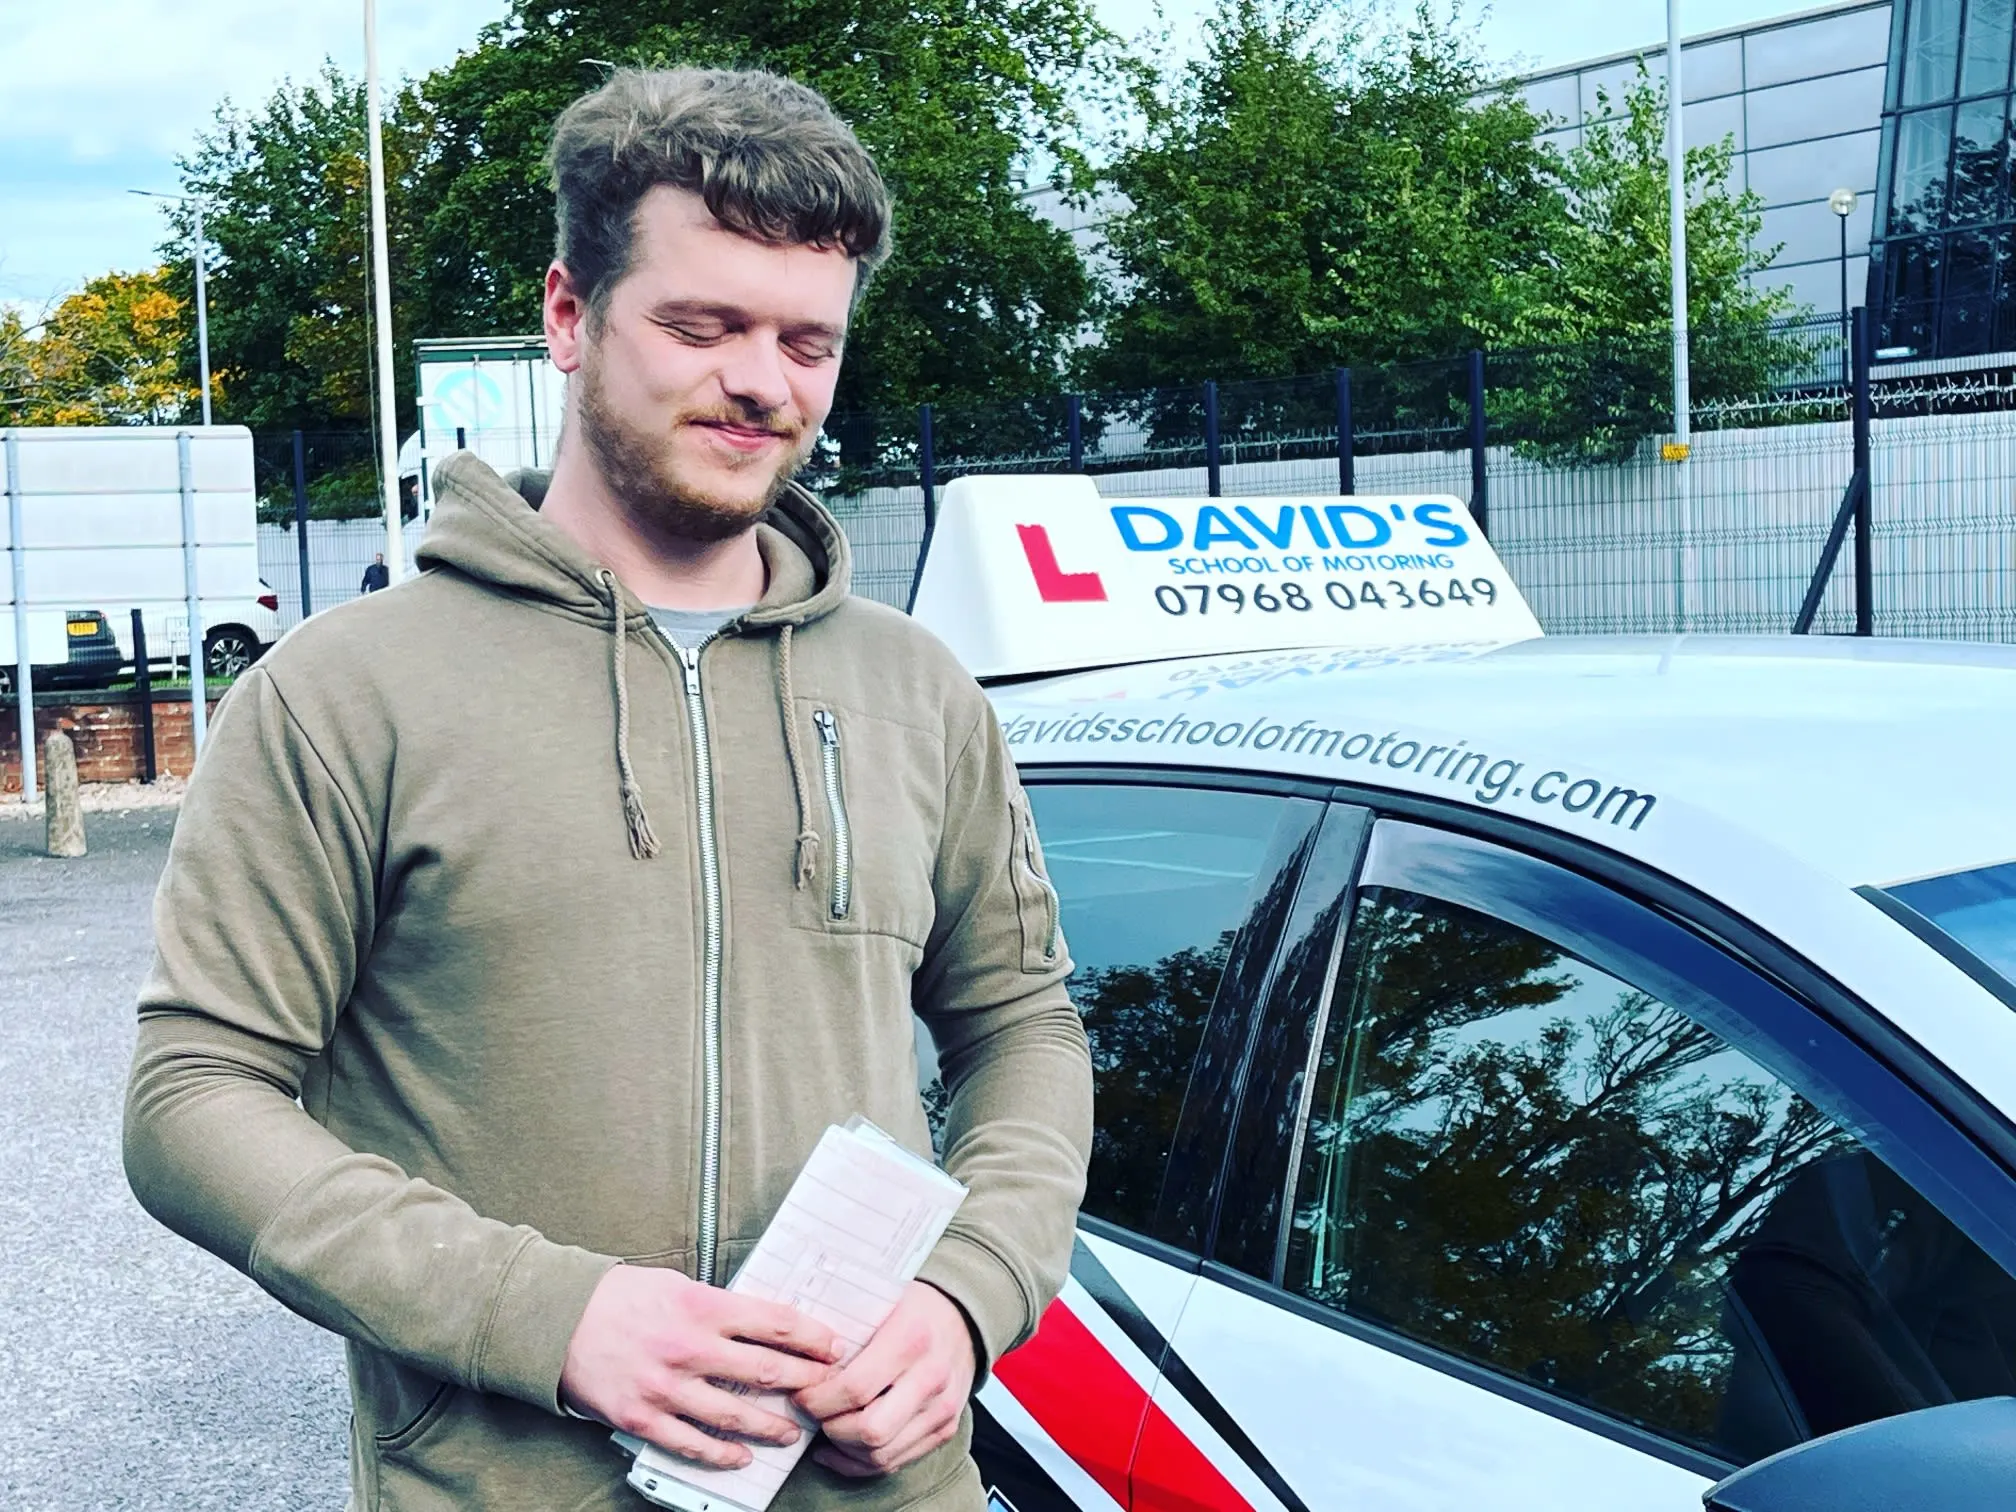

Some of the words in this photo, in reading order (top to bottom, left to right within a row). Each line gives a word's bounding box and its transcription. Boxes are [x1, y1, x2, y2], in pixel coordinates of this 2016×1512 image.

[1110, 504, 1469, 551] DAVID'S
[1015, 523, 1108, 603] L
[1168, 556, 1279, 575] SCHOOL
[1282, 555, 1314, 573] OF
[1322, 553, 1455, 572] MOTORING
[1154, 581, 1313, 616] 07968
[1325, 577, 1498, 610] 043649
